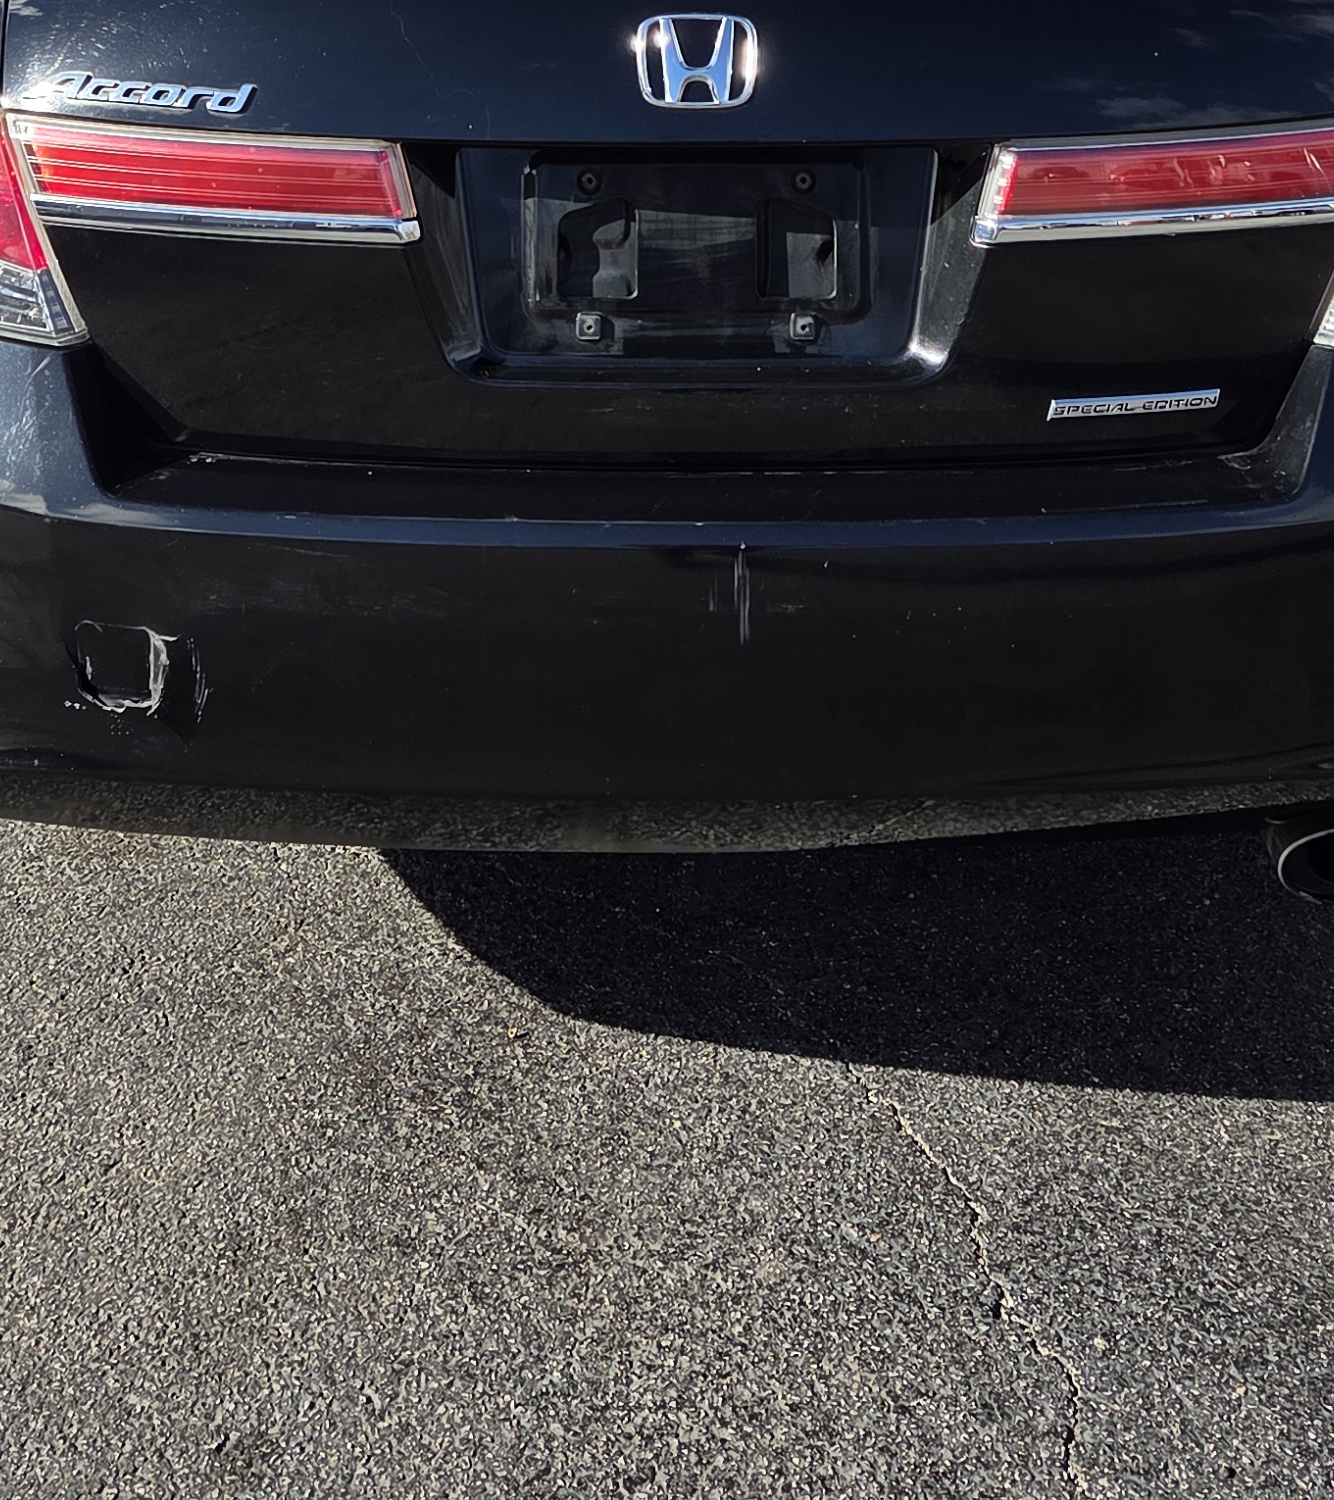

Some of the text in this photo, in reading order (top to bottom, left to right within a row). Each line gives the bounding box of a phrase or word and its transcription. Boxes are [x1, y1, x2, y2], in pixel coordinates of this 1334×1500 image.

[21, 70, 259, 115] Accord
[1053, 395, 1218, 416] SPECIAL EDITION
